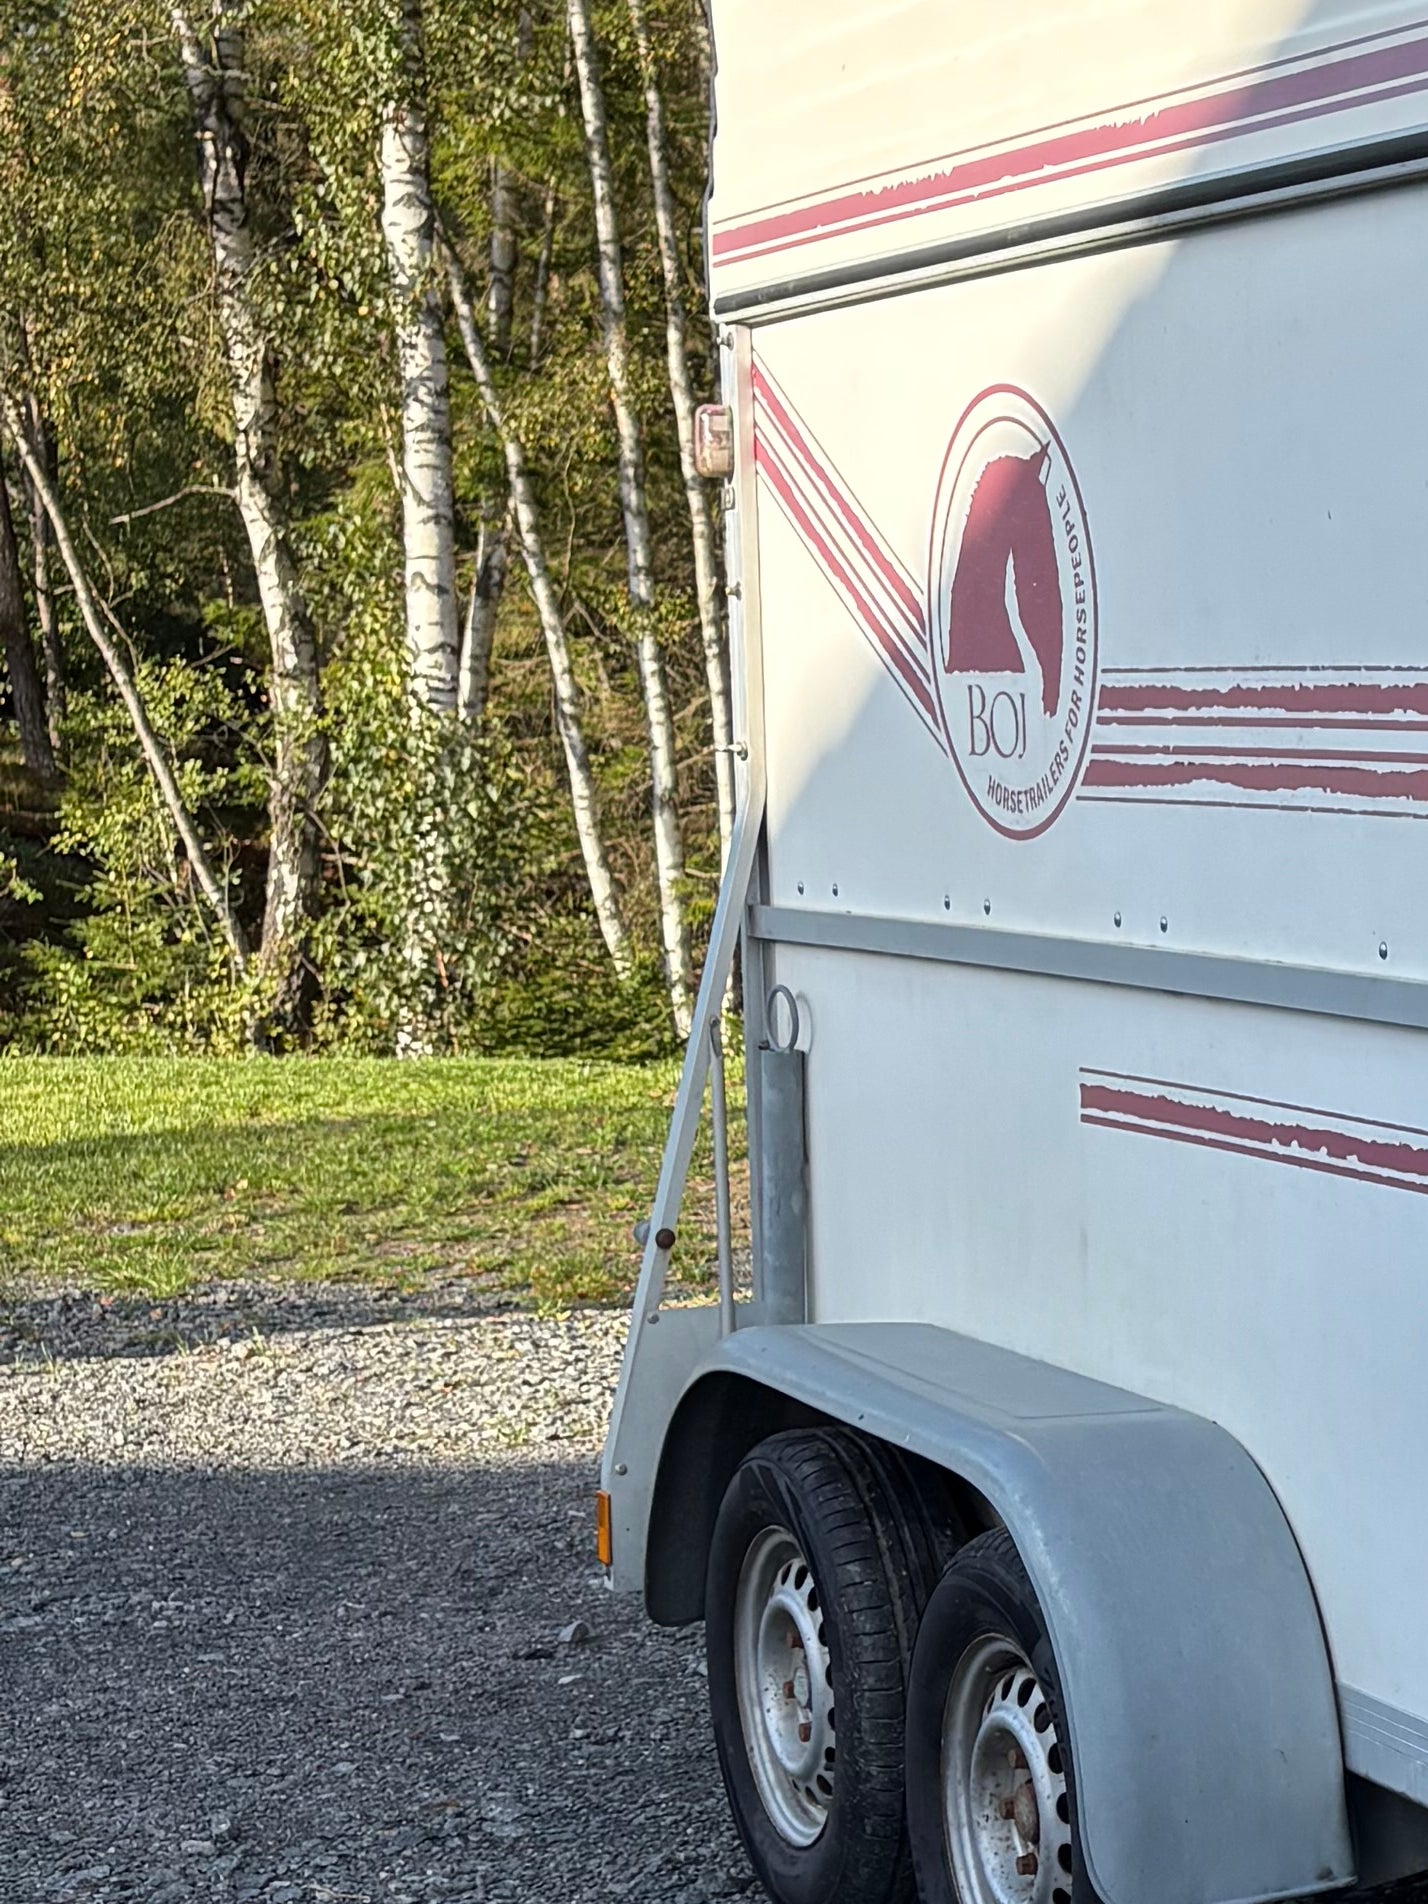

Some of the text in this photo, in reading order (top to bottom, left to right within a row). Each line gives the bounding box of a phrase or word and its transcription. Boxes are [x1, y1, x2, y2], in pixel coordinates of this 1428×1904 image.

[967, 683, 1027, 760] BOJ
[987, 484, 1087, 814] HORSETRAILERS FOR HORSEPEOPLE
